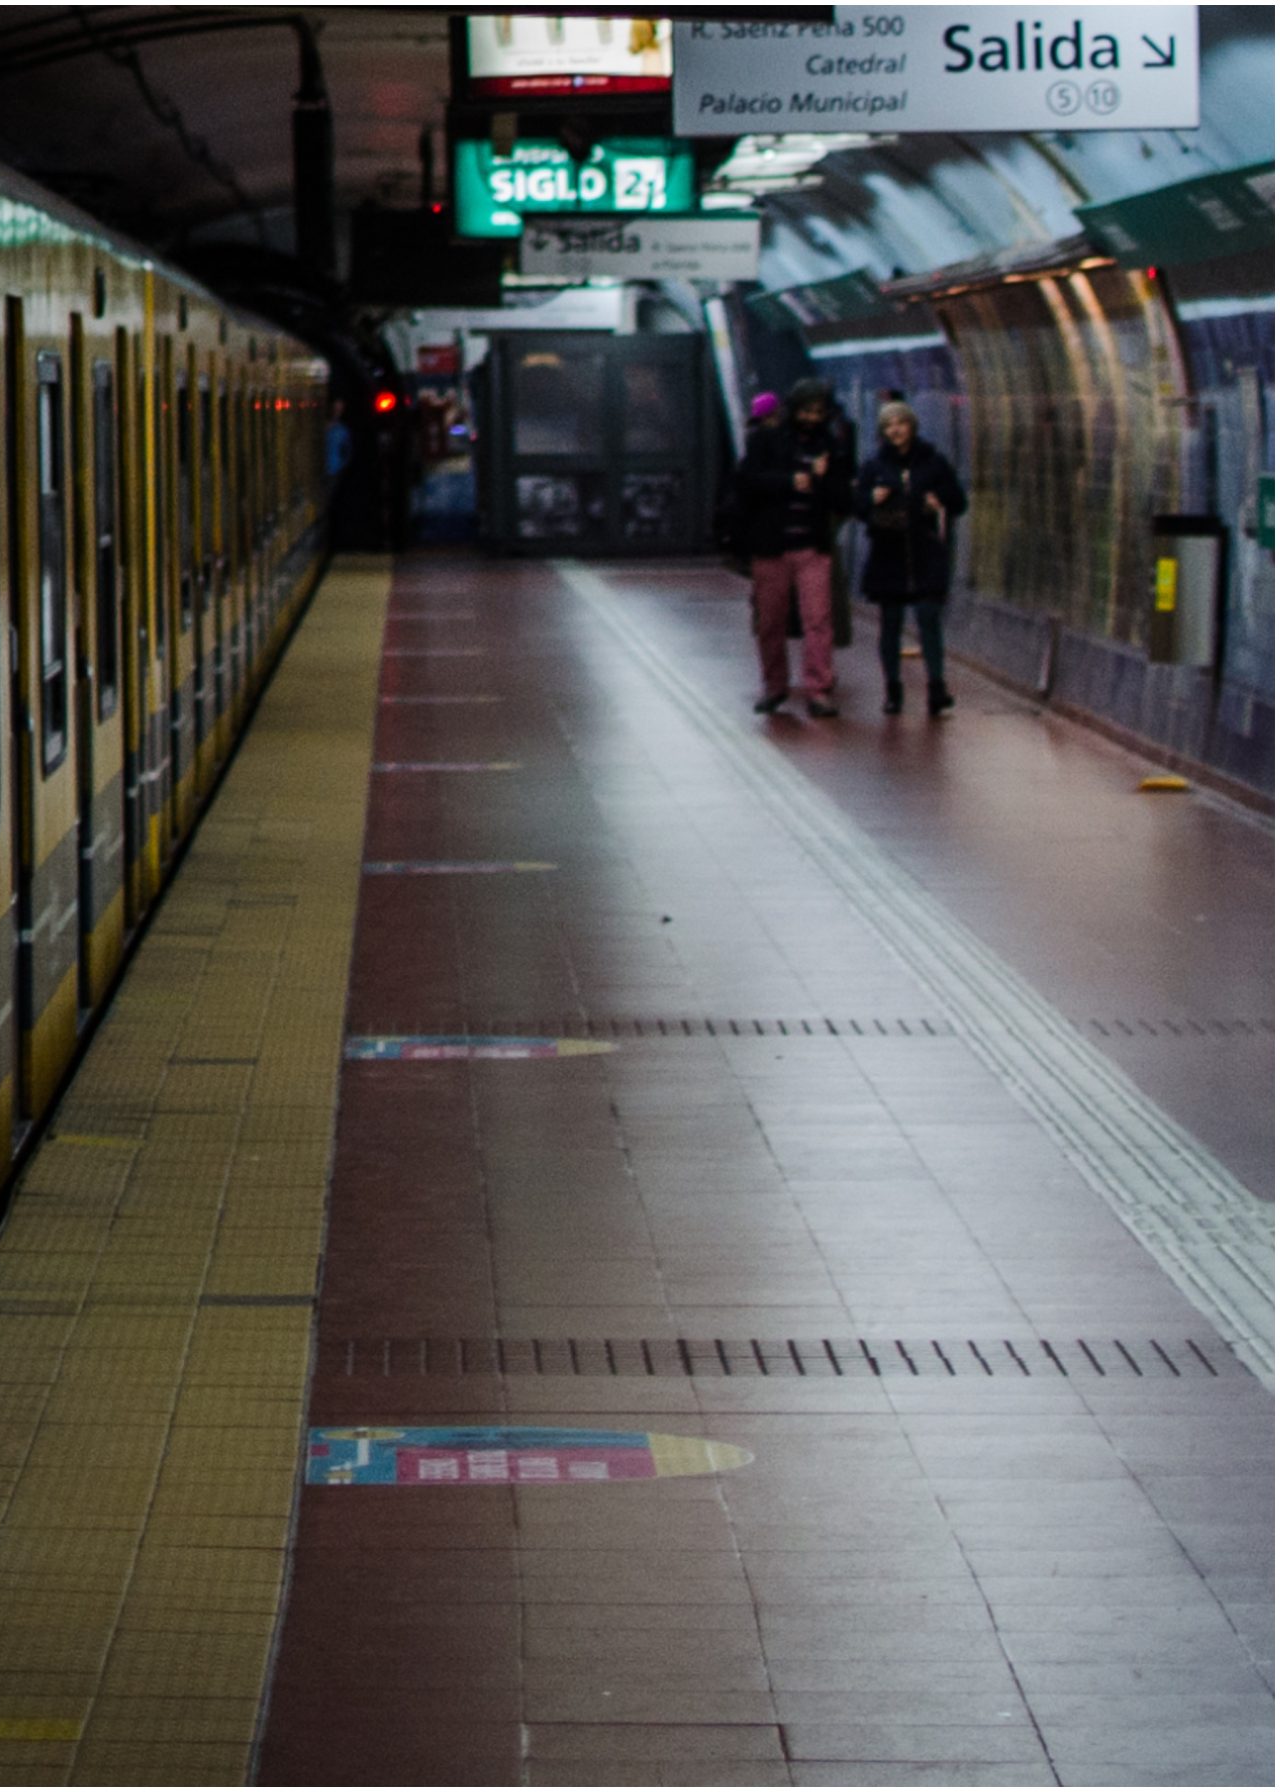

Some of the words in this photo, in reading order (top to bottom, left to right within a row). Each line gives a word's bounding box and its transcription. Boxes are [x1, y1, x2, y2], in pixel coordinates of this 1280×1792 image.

[862, 15, 904, 37] 500
[943, 19, 1120, 74] Salida
[805, 54, 907, 76] Catedral
[698, 93, 783, 115] Palacio
[789, 90, 908, 116] Municipal
[489, 167, 608, 203] SIGLO
[558, 229, 642, 254] Salida
